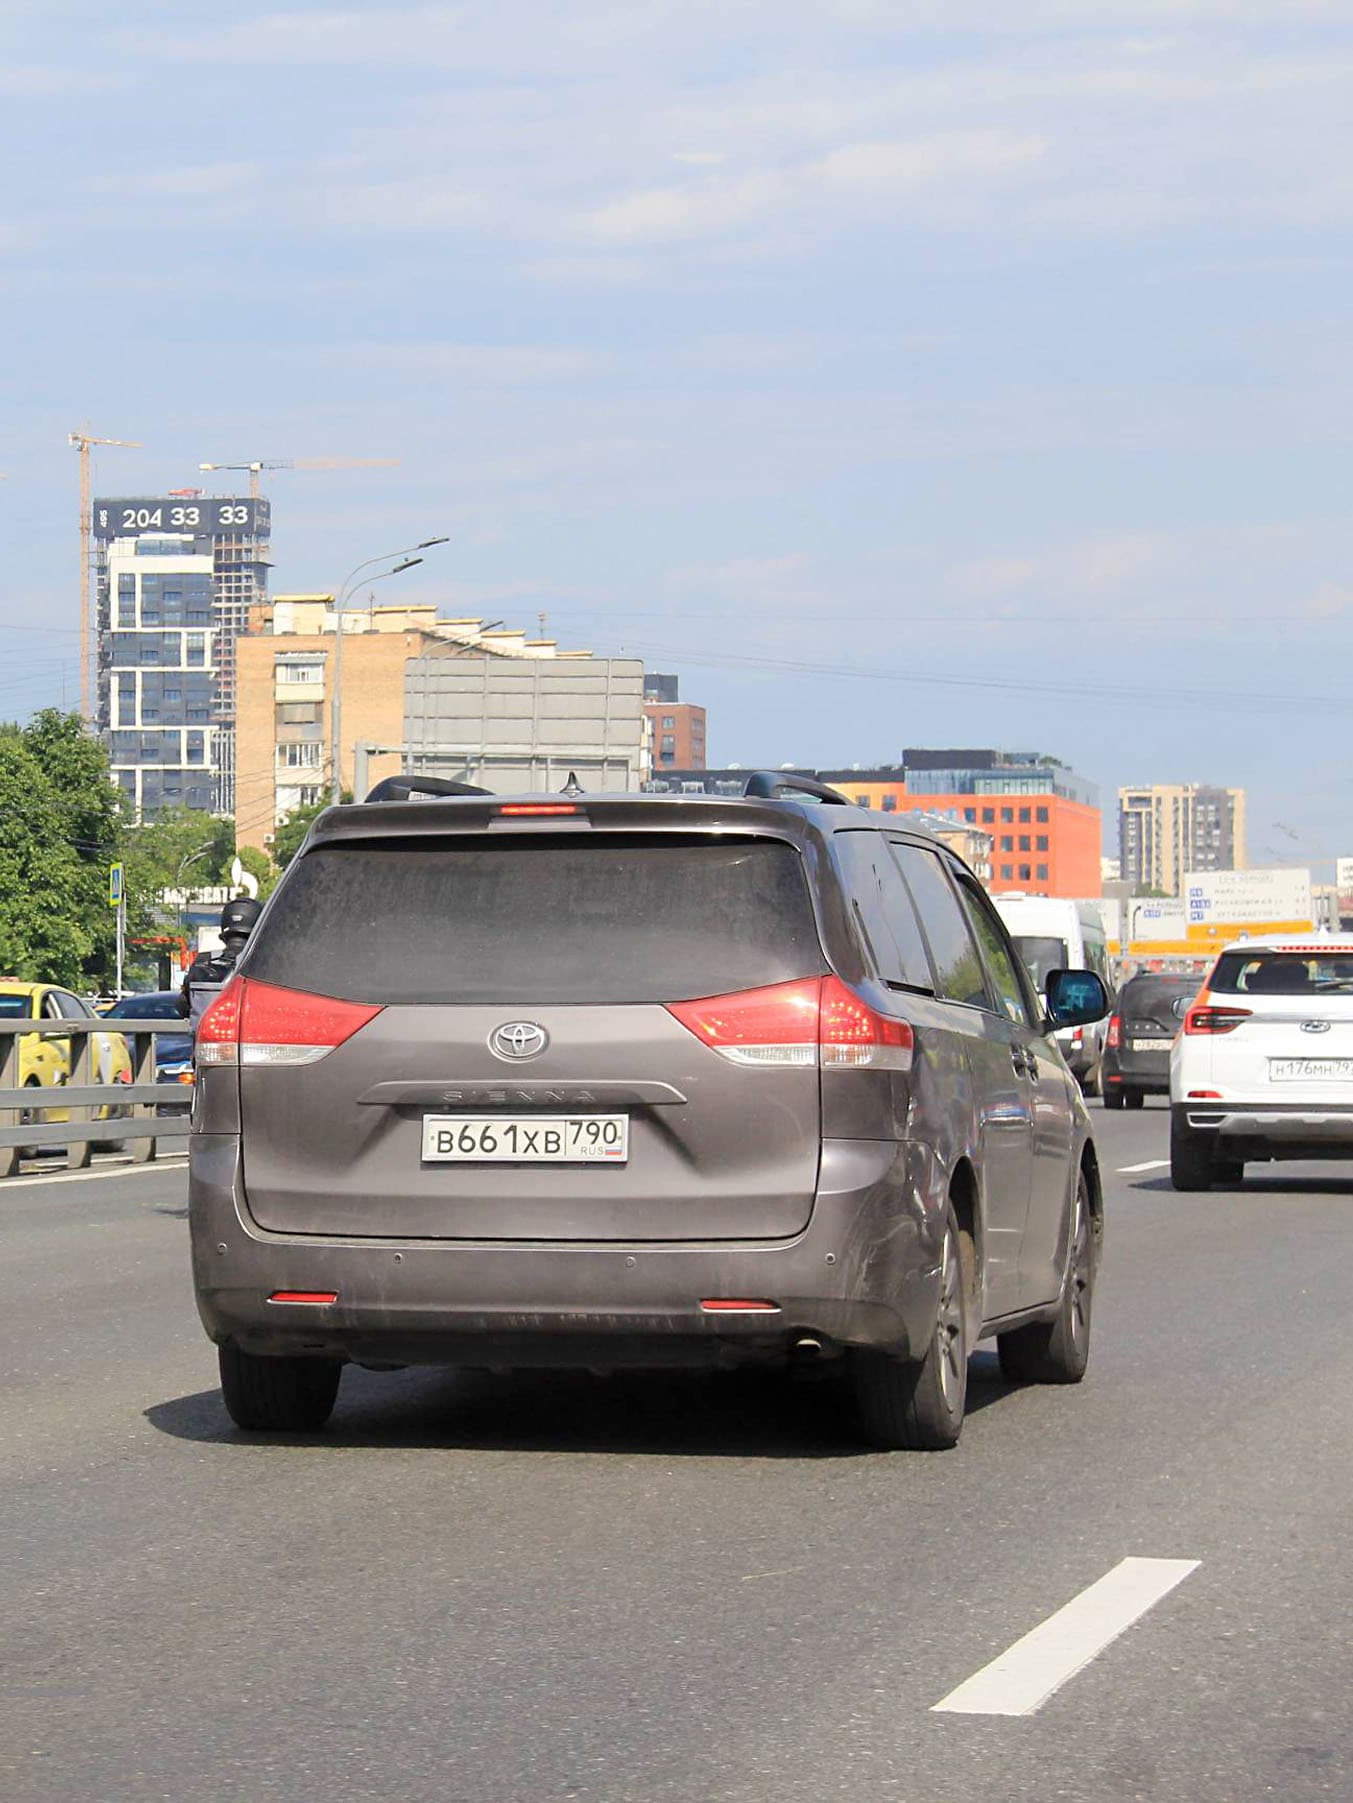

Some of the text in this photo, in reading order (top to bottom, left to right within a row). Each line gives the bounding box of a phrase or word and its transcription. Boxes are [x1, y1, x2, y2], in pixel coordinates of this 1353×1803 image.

[122, 508, 163, 528] 204
[170, 507, 200, 526] 33
[219, 506, 248, 524] 33
[569, 1121, 618, 1145] 790
[580, 1147, 605, 1156] RUS
